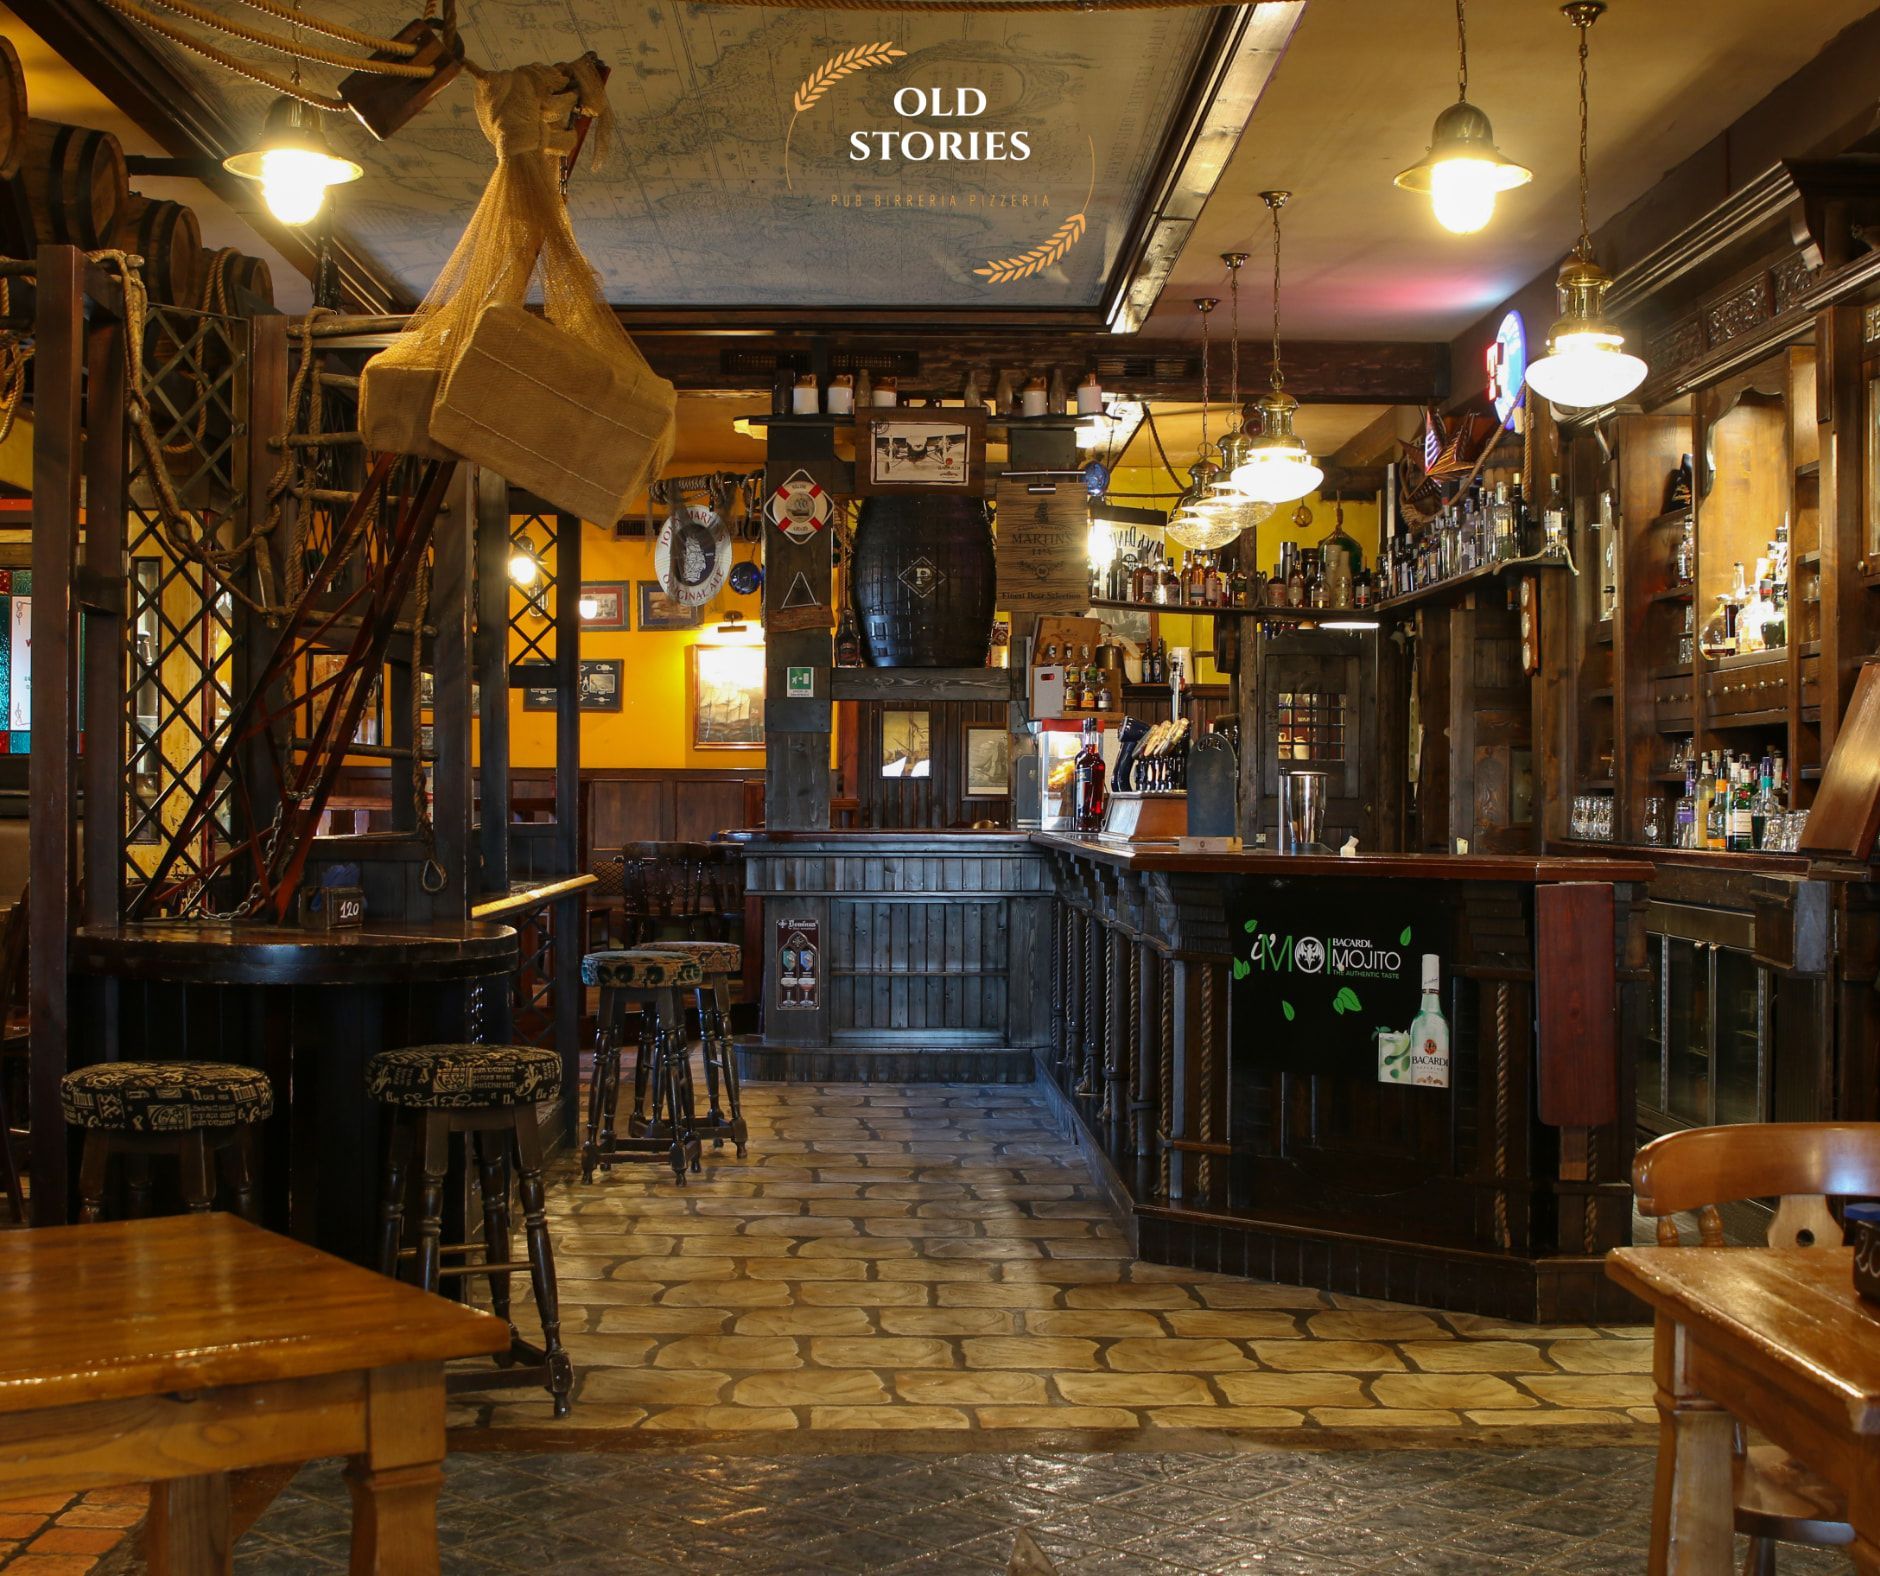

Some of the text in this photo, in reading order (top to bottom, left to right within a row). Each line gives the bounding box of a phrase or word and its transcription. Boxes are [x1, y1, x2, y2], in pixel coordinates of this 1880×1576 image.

[340, 901, 360, 919] 120
[1332, 937, 1372, 948] BACARDI
[1332, 948, 1401, 971] MOJITO
[1346, 970, 1380, 978] AUTHENTIC
[1381, 972, 1400, 980] TASTE
